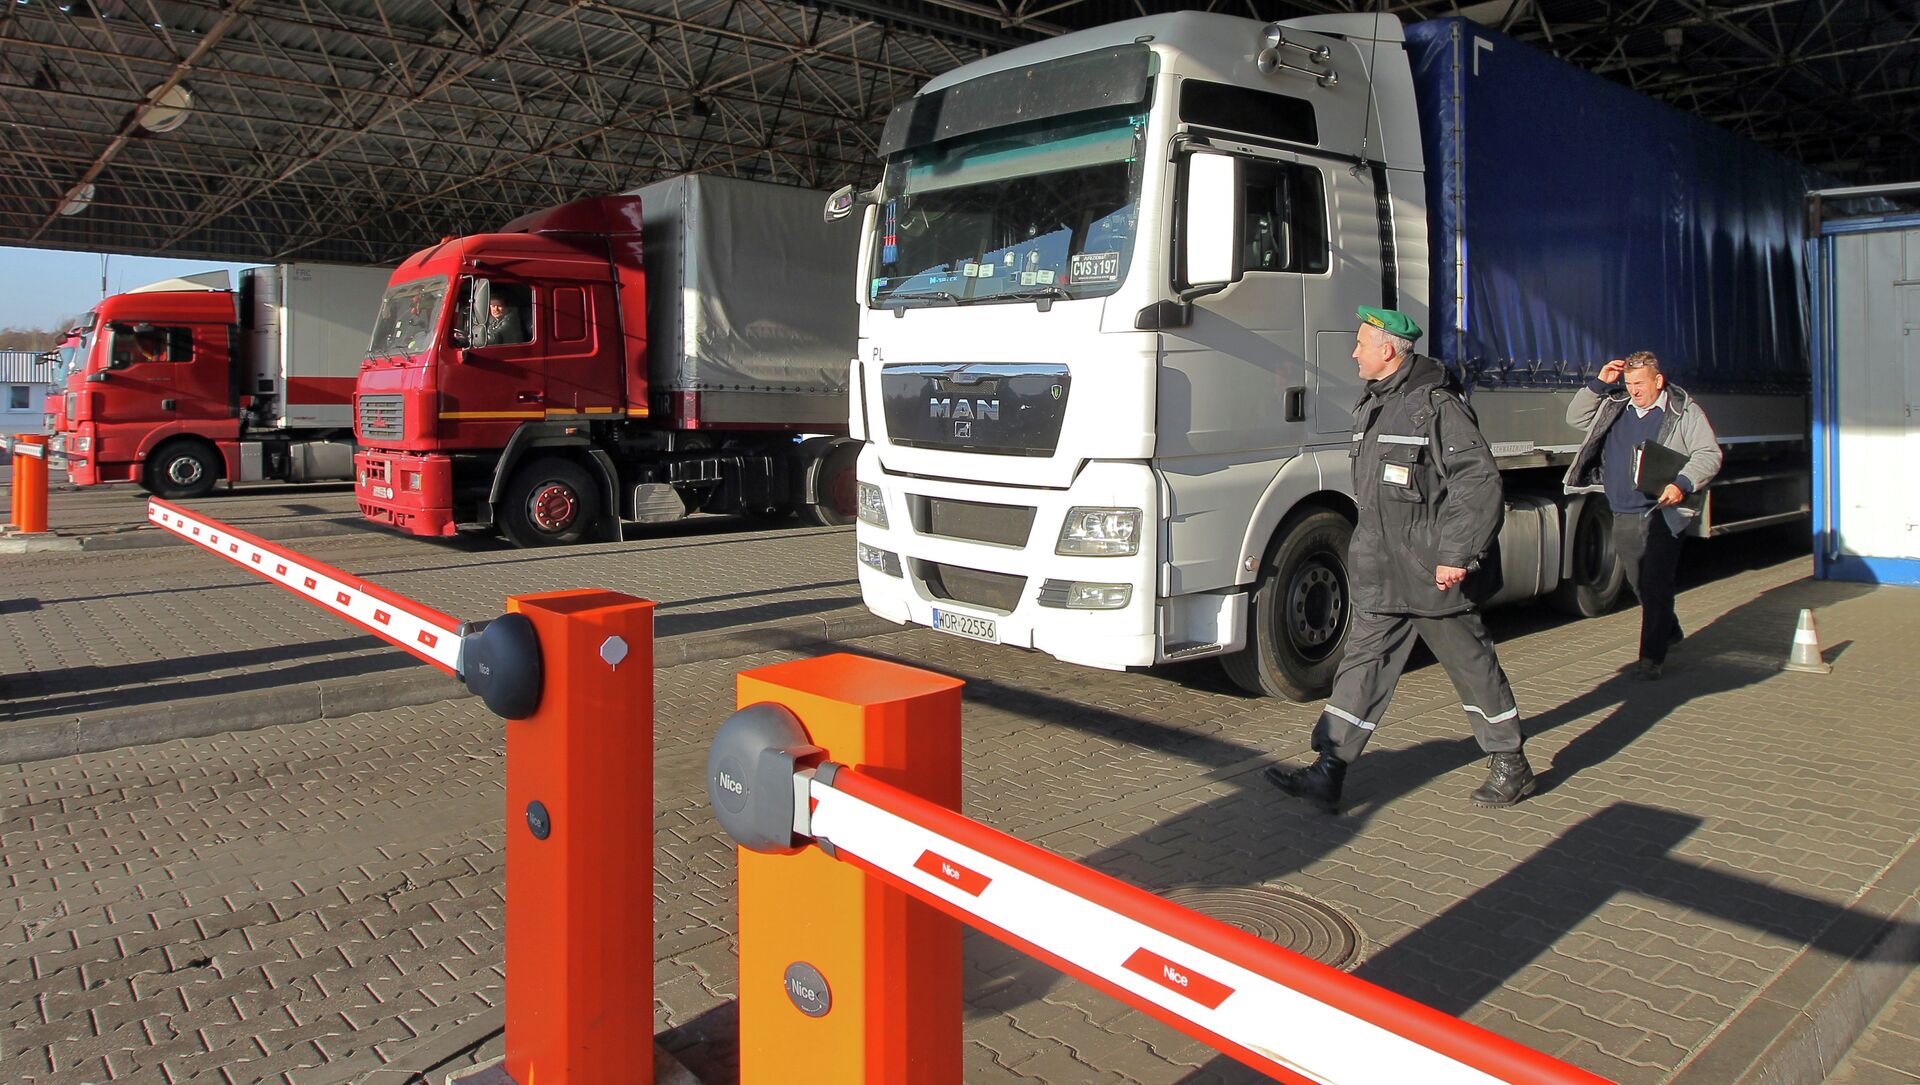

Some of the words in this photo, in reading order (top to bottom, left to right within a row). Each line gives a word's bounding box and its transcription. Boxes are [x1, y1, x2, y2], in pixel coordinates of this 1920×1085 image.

[1073, 260, 1092, 276] CVS
[1099, 259, 1116, 274] 197
[873, 347, 884, 361] PL
[929, 397, 1000, 420] MAN
[938, 611, 957, 631] WOR
[960, 617, 994, 638] 22556
[719, 771, 743, 795] Nice
[942, 862, 960, 880] Nice
[1163, 964, 1189, 987] Nice
[791, 978, 815, 1001] Nice
